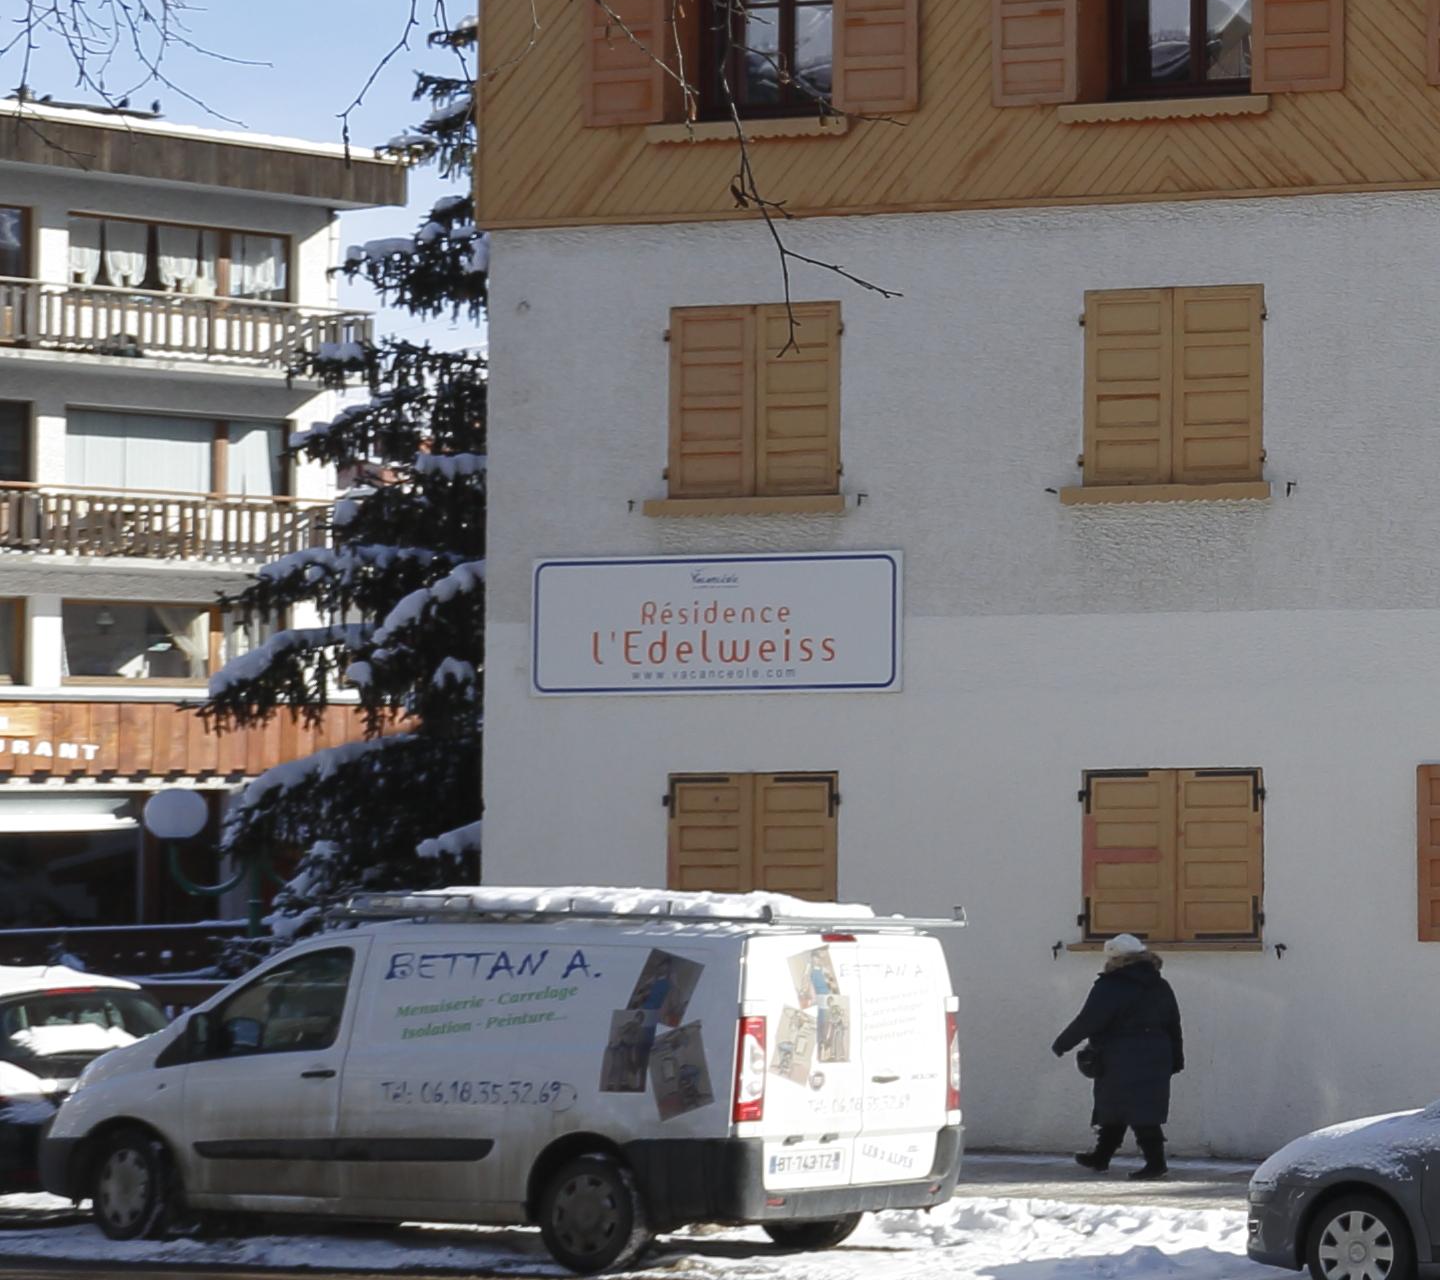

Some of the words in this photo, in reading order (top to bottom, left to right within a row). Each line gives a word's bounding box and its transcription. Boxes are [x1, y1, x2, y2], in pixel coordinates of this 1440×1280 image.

[640, 600, 792, 626] Résidence
[592, 629, 837, 665] l'Edelweiss
[384, 949, 550, 980] BETTAN
[561, 949, 602, 979] A.
[395, 994, 485, 1018] Menuiserie
[497, 985, 579, 1006] Carrelage
[401, 1020, 472, 1040] Isolation
